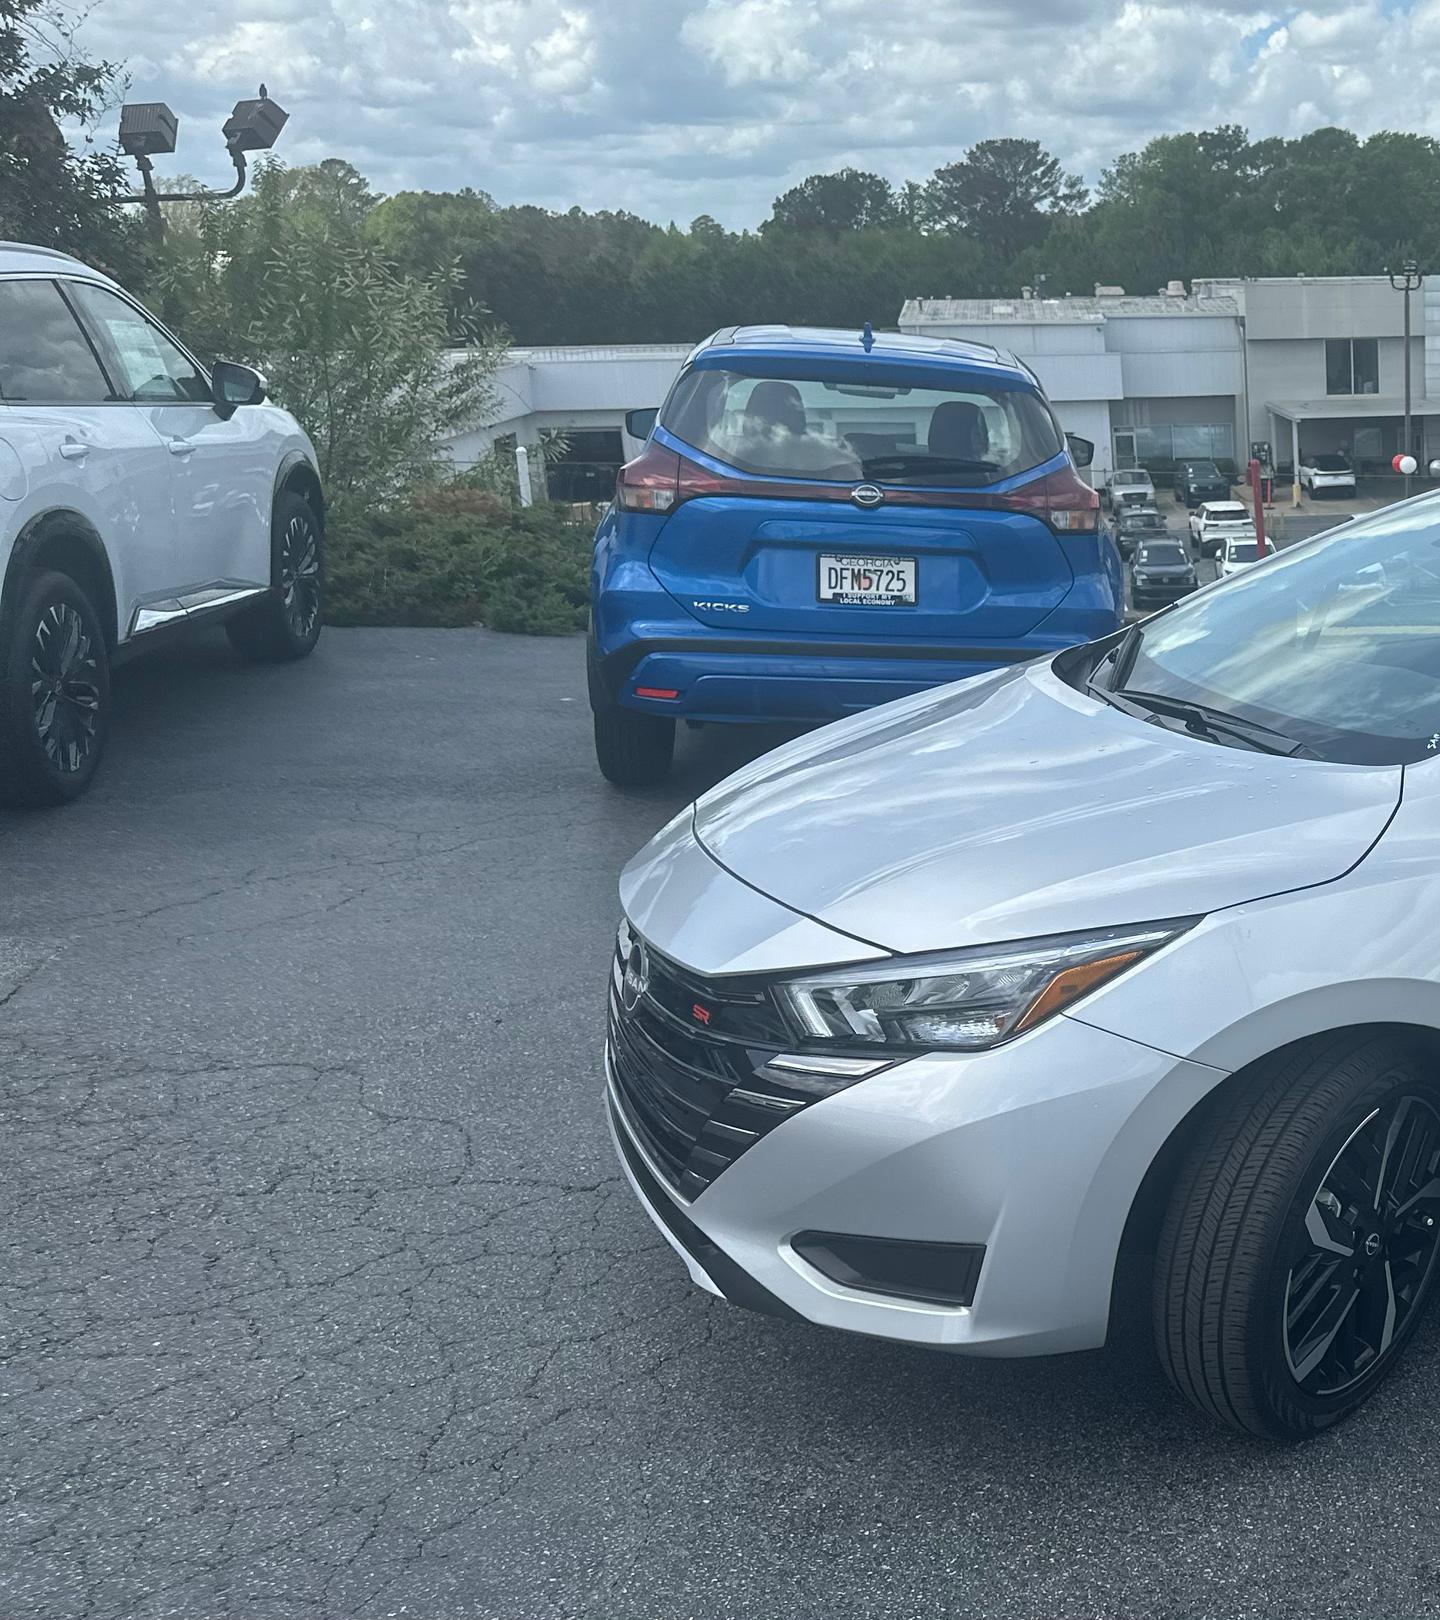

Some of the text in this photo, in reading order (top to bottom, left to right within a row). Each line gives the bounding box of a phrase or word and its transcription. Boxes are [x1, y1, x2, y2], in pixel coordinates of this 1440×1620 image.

[840, 558, 895, 569] GEORGIA
[828, 567, 906, 592] DFM5725
[693, 601, 750, 613] KICKS
